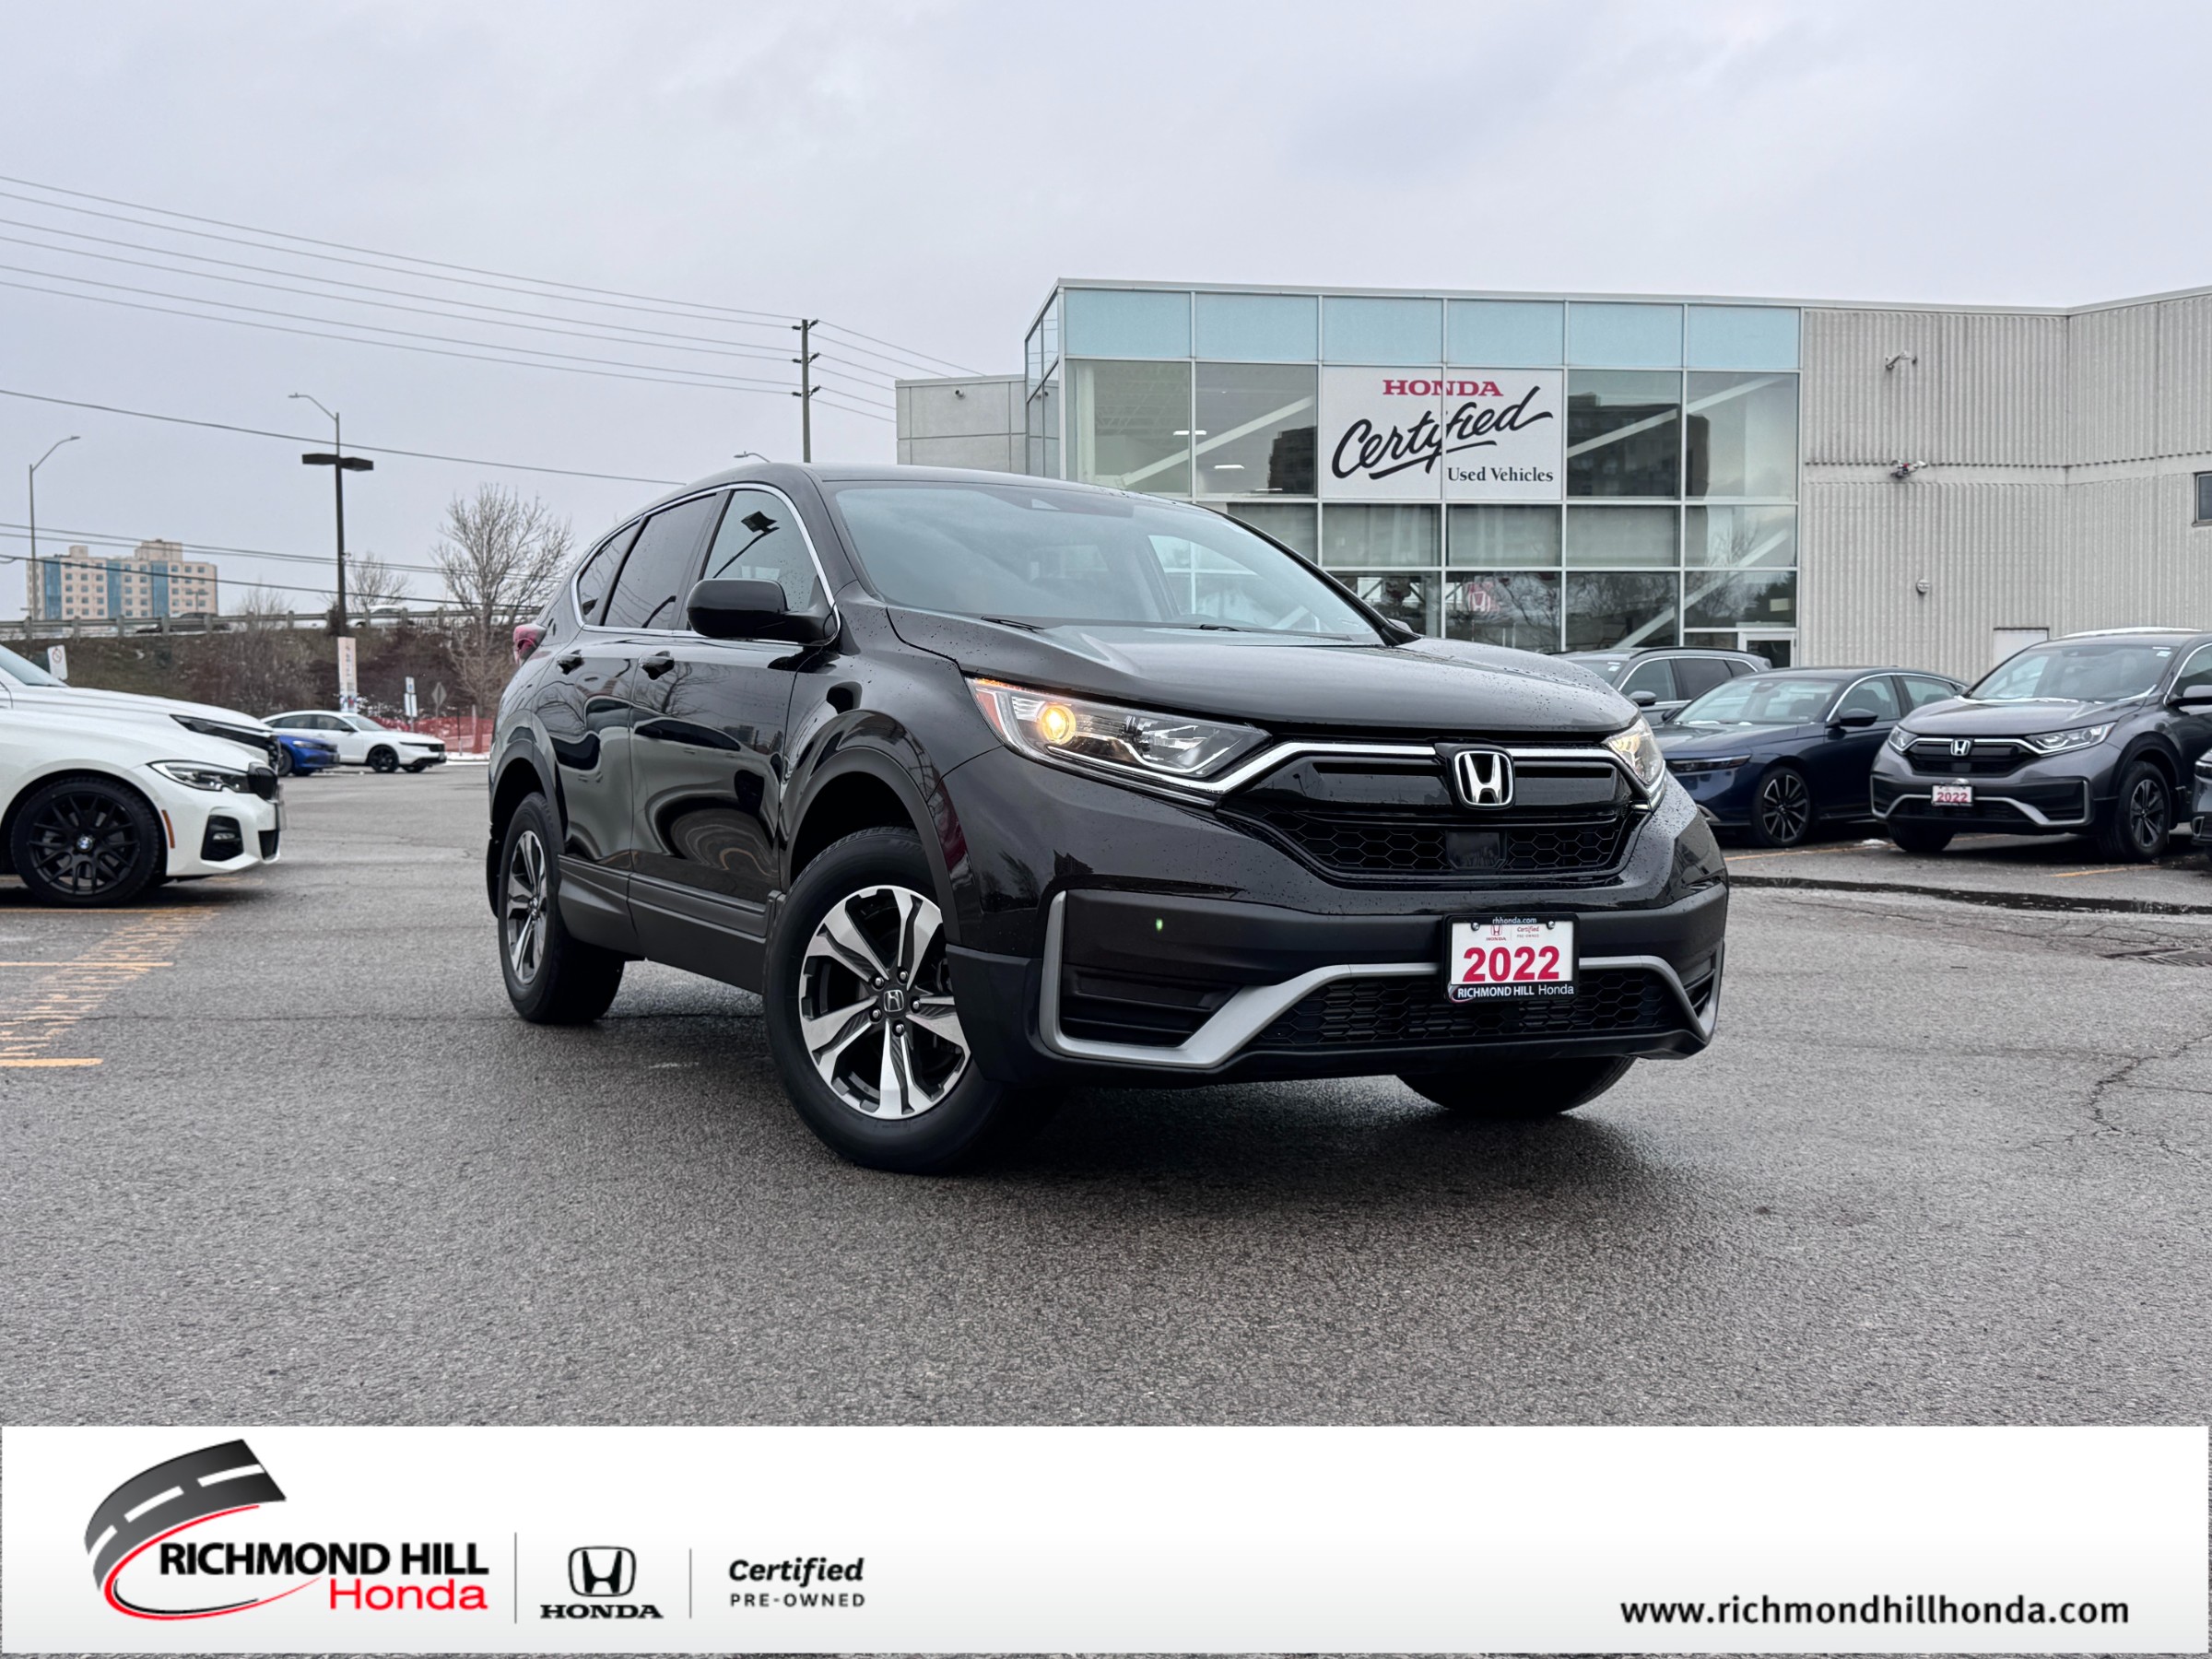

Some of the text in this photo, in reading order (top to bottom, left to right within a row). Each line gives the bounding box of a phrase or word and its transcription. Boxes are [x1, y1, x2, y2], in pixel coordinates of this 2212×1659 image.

[1383, 380, 1503, 396] HONDA
[1332, 385, 1553, 479] Certified
[1448, 467, 1554, 482] Used Vehicles
[1937, 792, 1968, 803] 2022
[1492, 916, 1537, 924] rhhonda.com
[1463, 946, 1559, 982] 2022
[1457, 984, 1574, 998] RICHMOND HILL Honda
